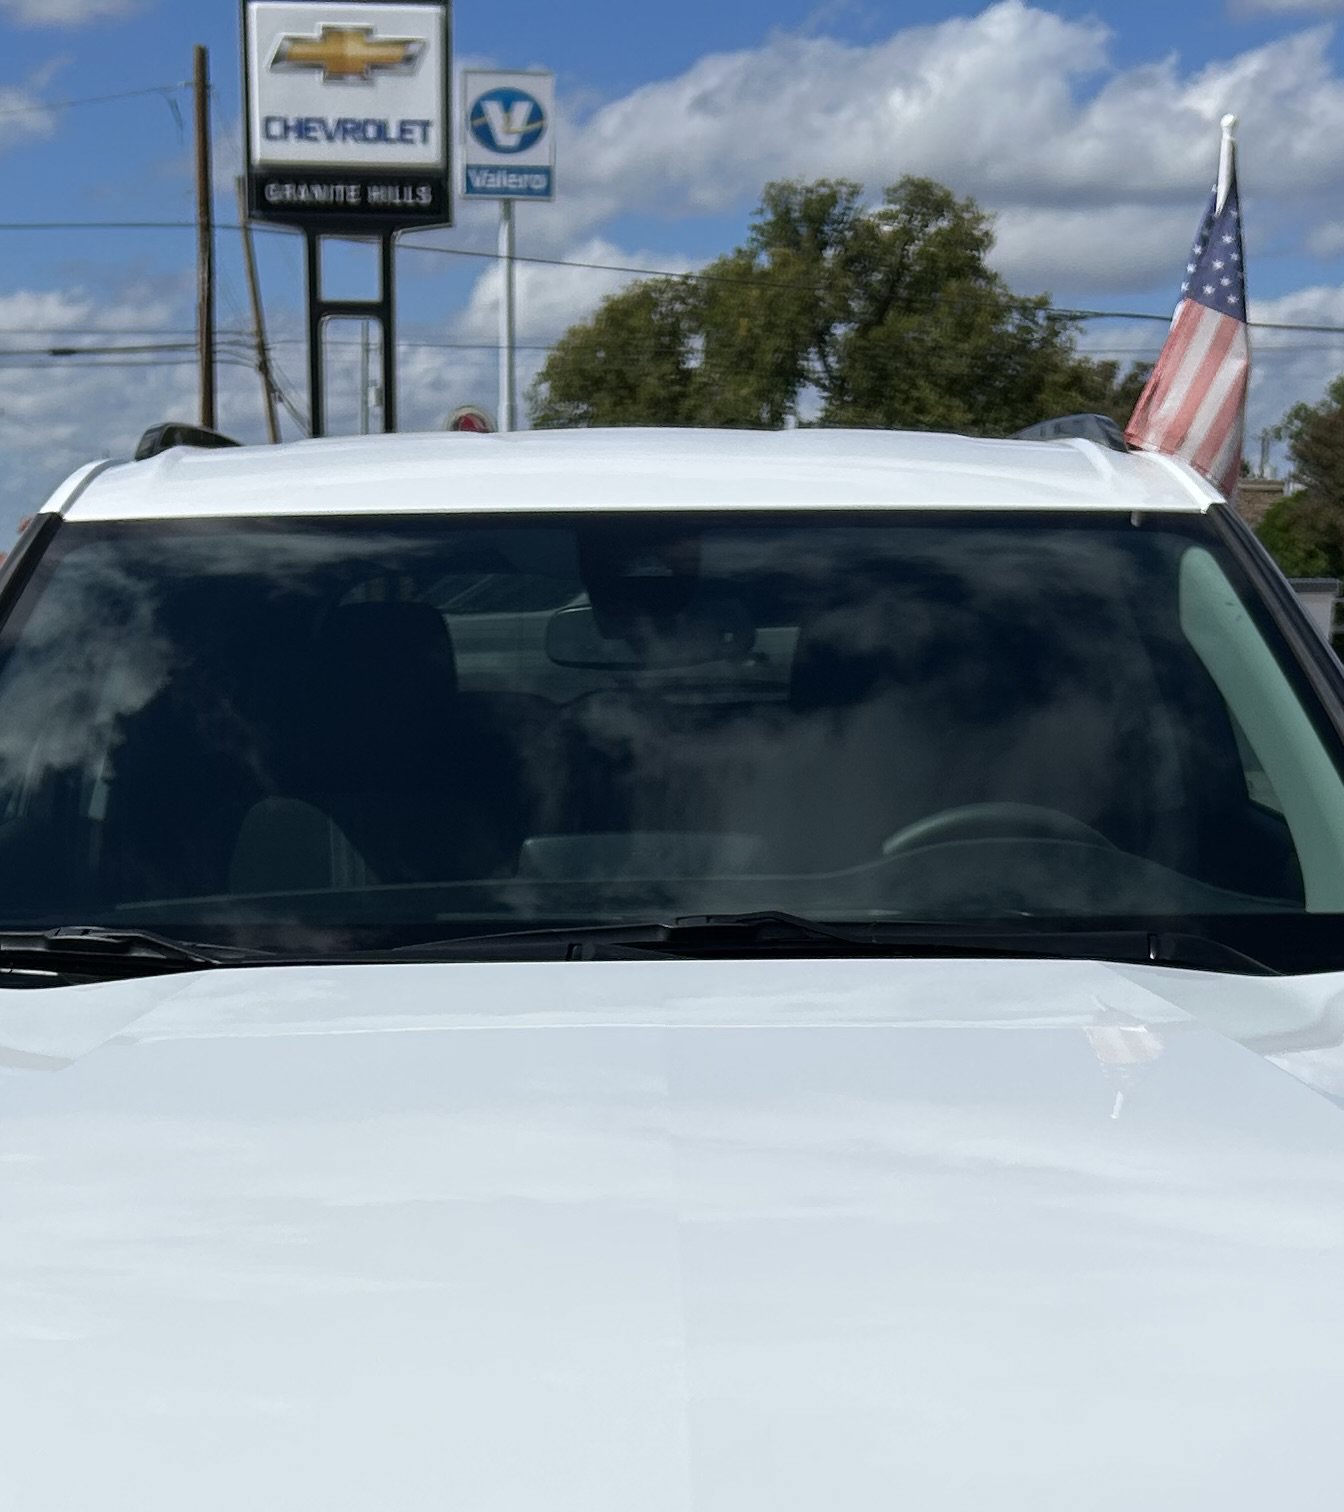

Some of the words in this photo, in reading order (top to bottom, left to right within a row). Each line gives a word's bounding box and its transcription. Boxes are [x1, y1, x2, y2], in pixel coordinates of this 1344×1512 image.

[264, 116, 432, 144] CHEVROLET
[264, 183, 361, 205] GRANITE
[367, 185, 433, 206] HILLS
